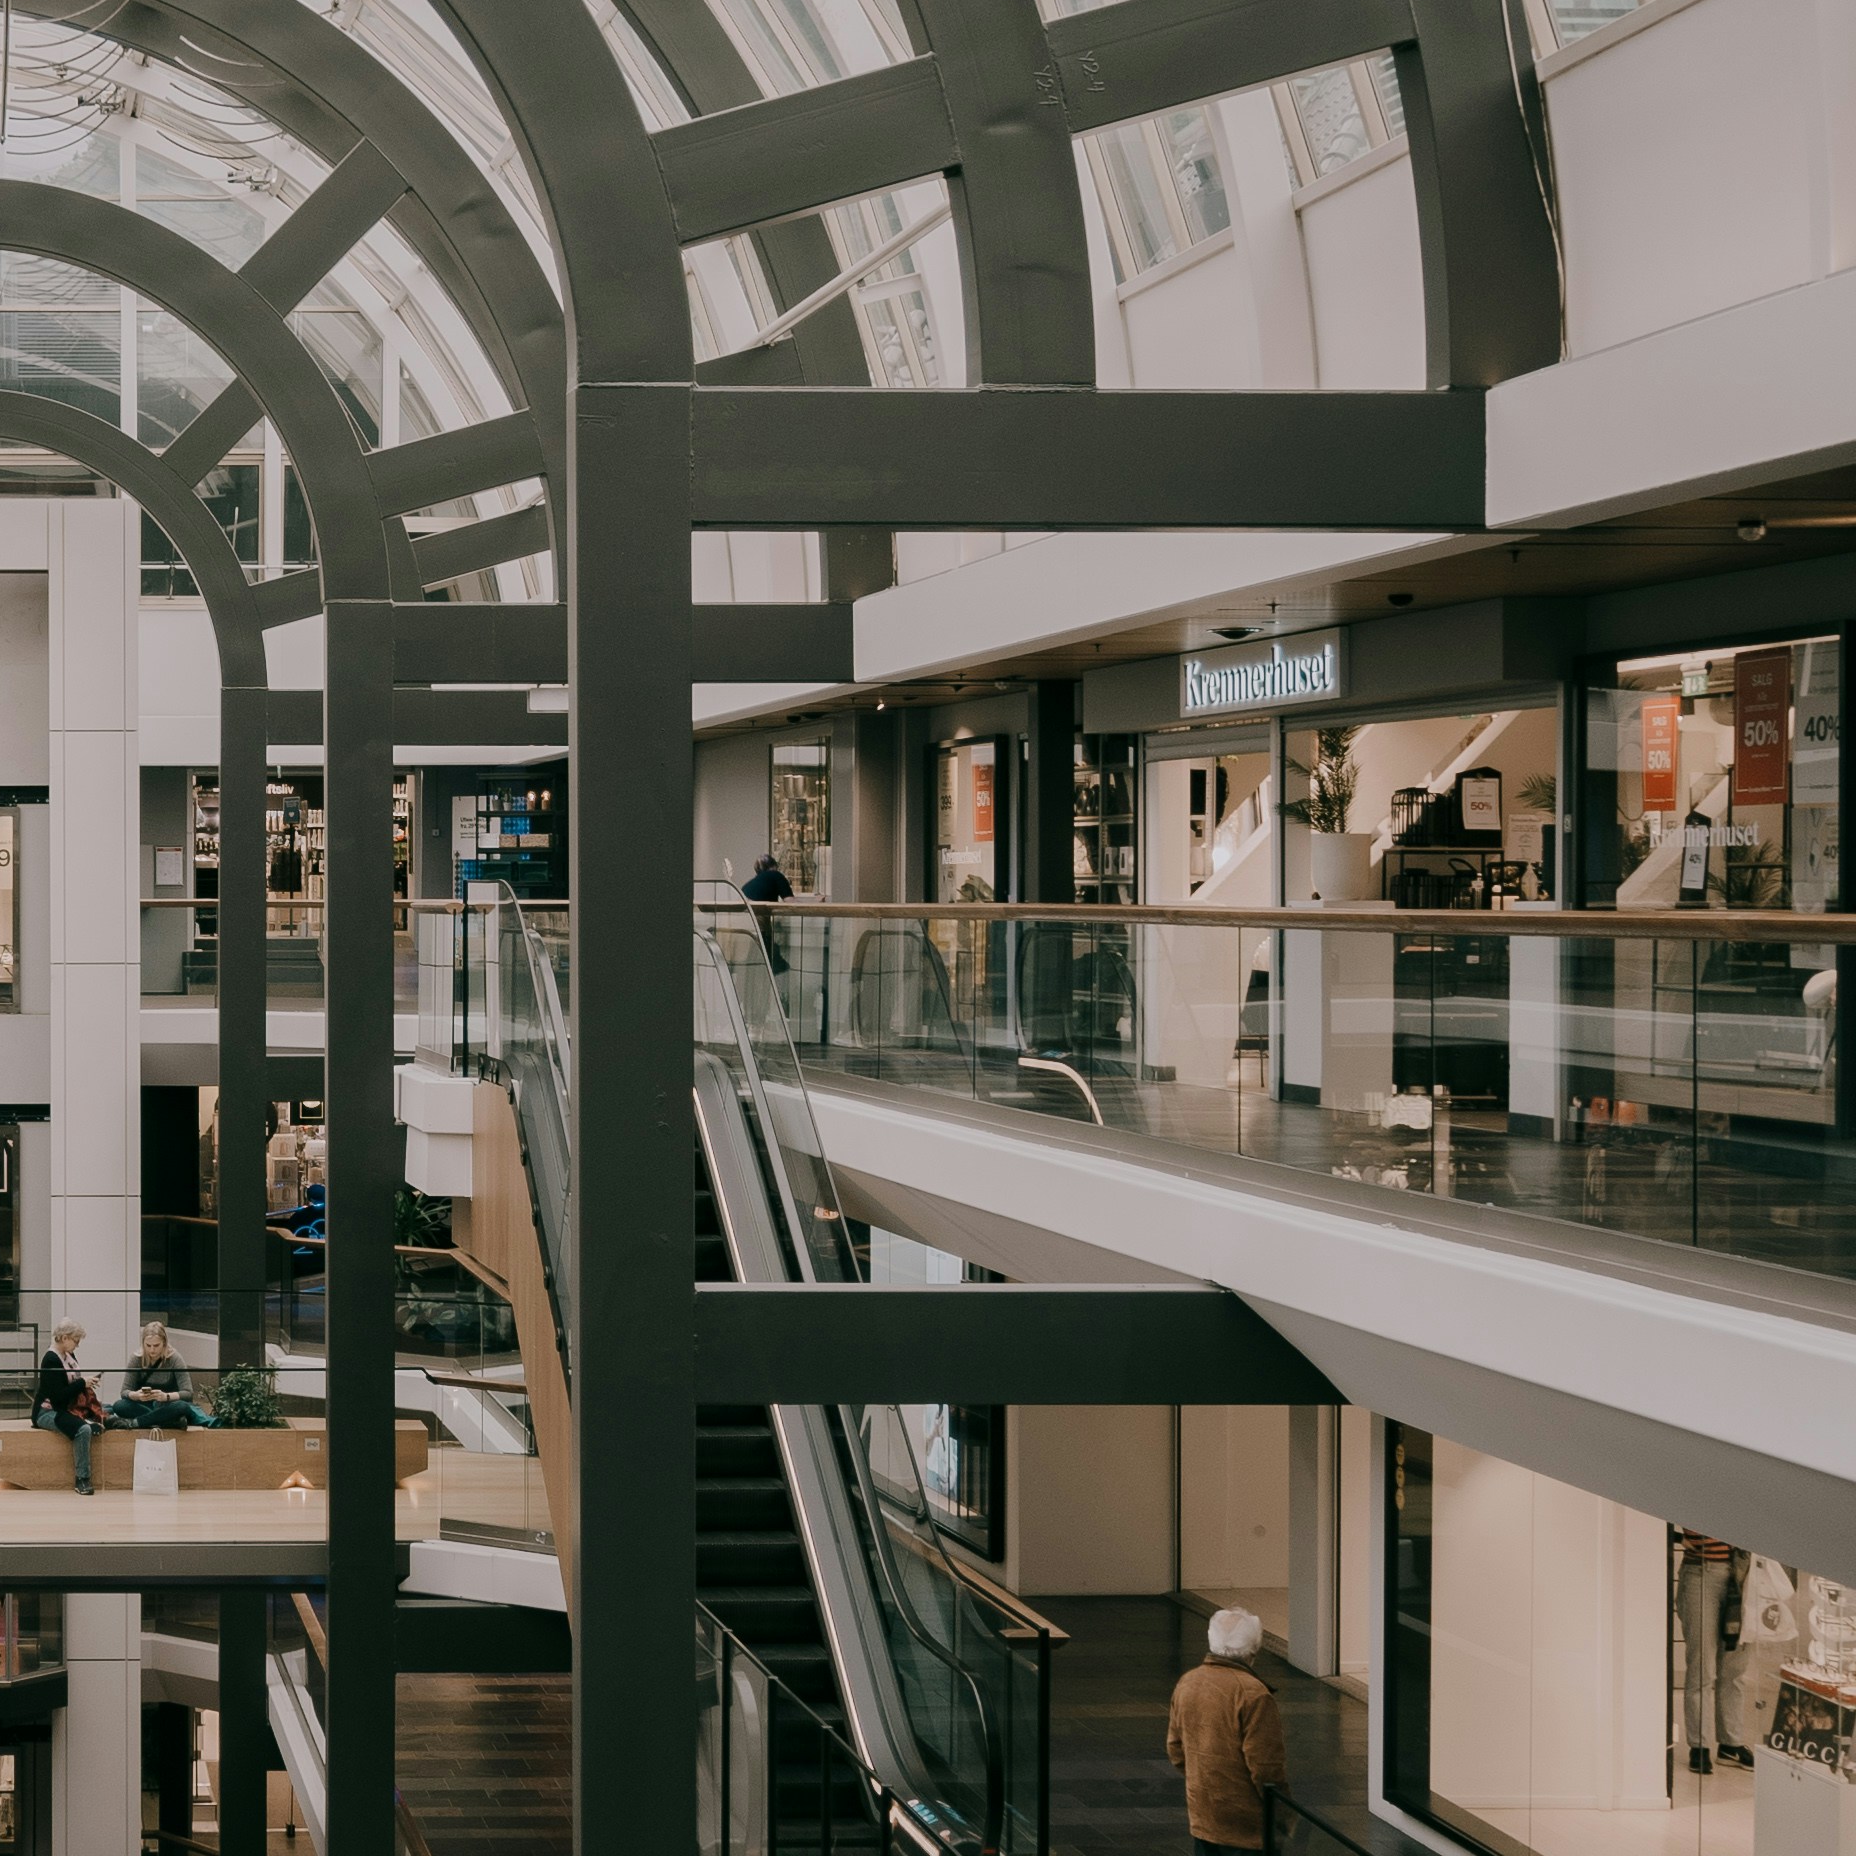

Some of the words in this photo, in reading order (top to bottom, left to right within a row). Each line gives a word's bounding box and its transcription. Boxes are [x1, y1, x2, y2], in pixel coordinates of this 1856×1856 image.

[1184, 643, 1334, 710] Kremmerhuset
[1744, 719, 1779, 747] 50%
[1647, 750, 1671, 770] 50%
